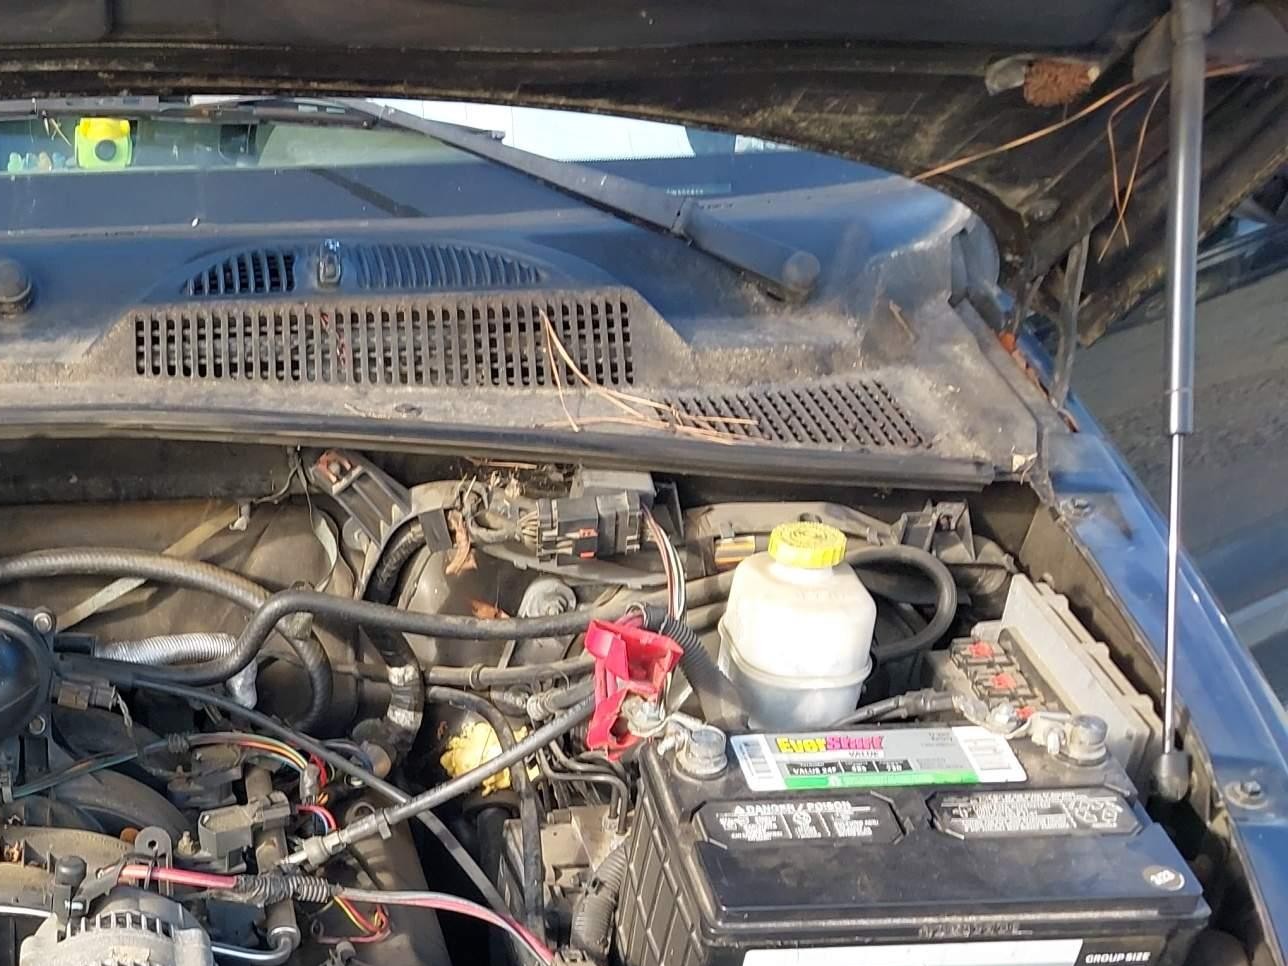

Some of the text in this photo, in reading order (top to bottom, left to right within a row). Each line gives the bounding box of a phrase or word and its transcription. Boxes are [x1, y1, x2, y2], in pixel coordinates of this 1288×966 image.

[776, 736, 885, 753] EverStart
[807, 801, 852, 813] POISON
[1085, 951, 1151, 963] GROUP SIZE
